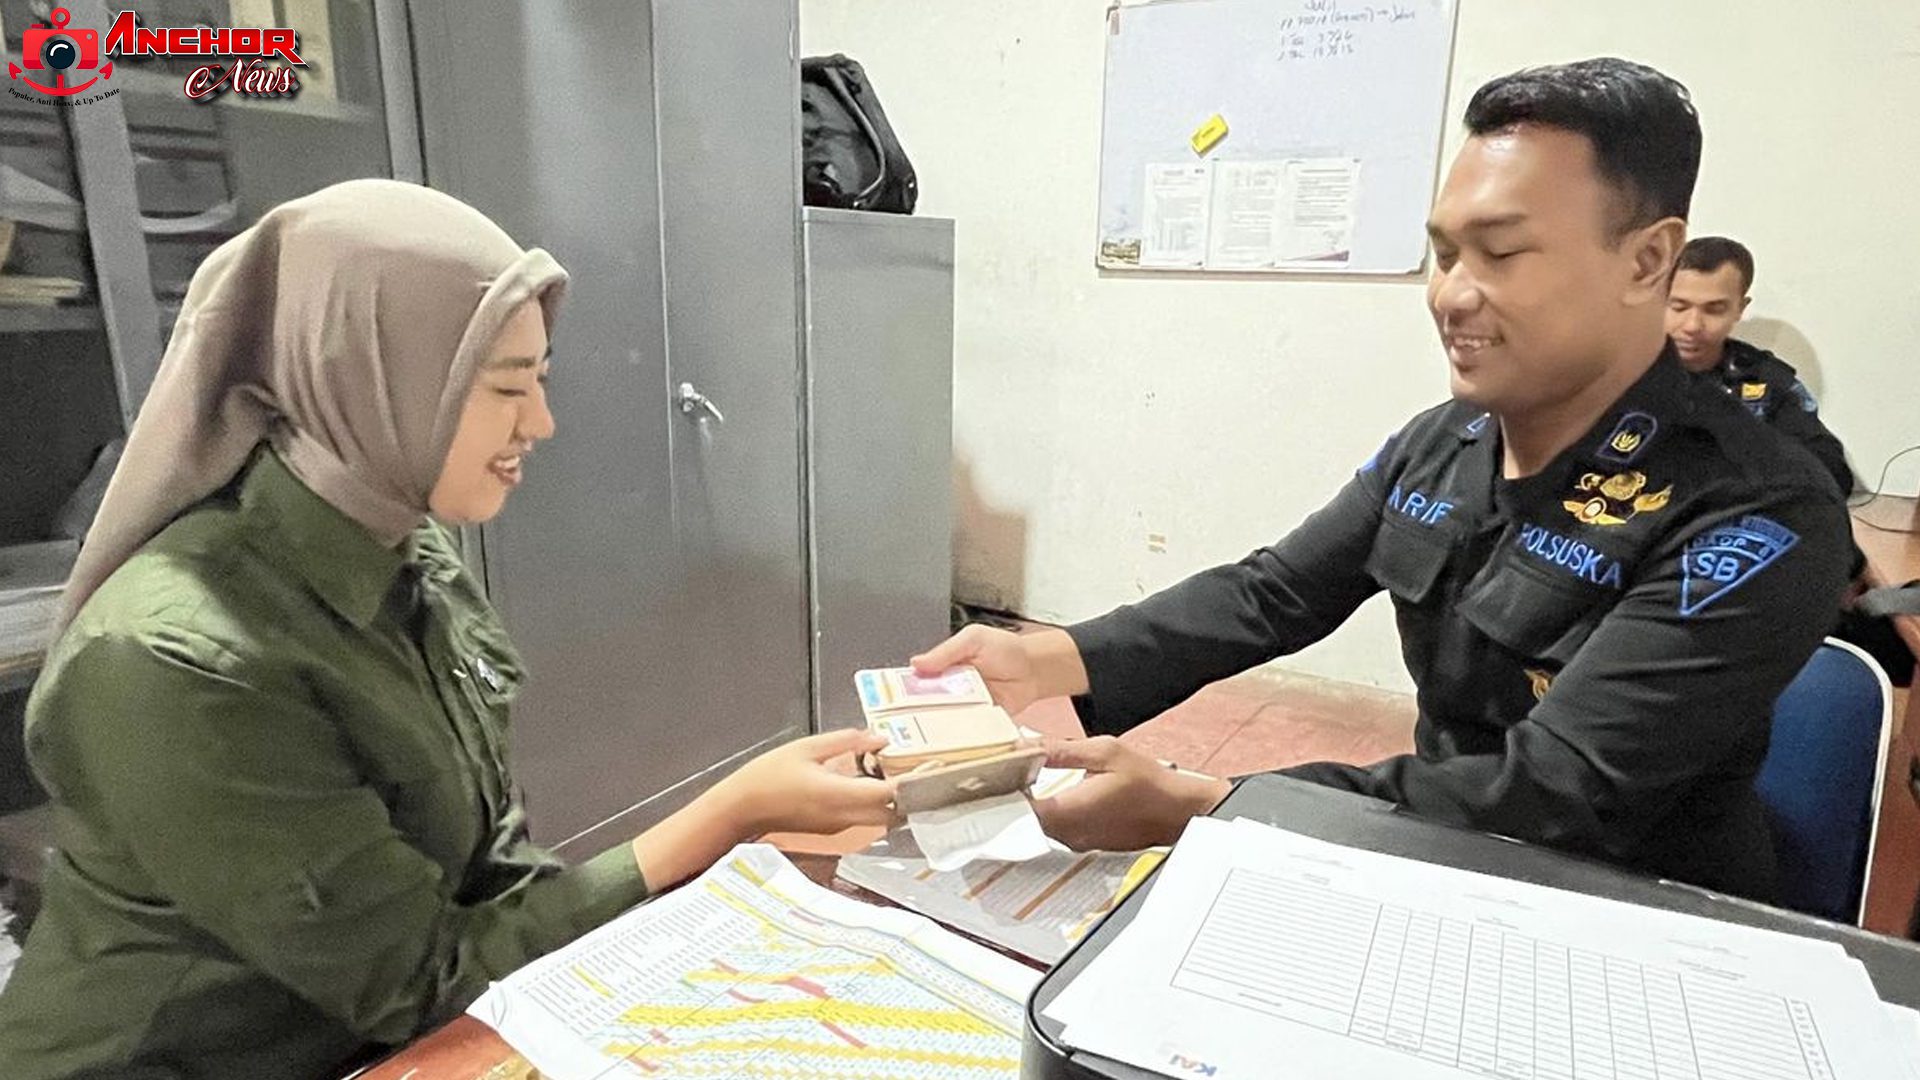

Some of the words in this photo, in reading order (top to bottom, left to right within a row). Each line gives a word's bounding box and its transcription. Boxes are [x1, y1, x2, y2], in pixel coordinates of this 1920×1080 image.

[1387, 484, 1454, 524] ARIF
[1518, 525, 1623, 588] POLSUSKA
[1692, 552, 1740, 582] SB
